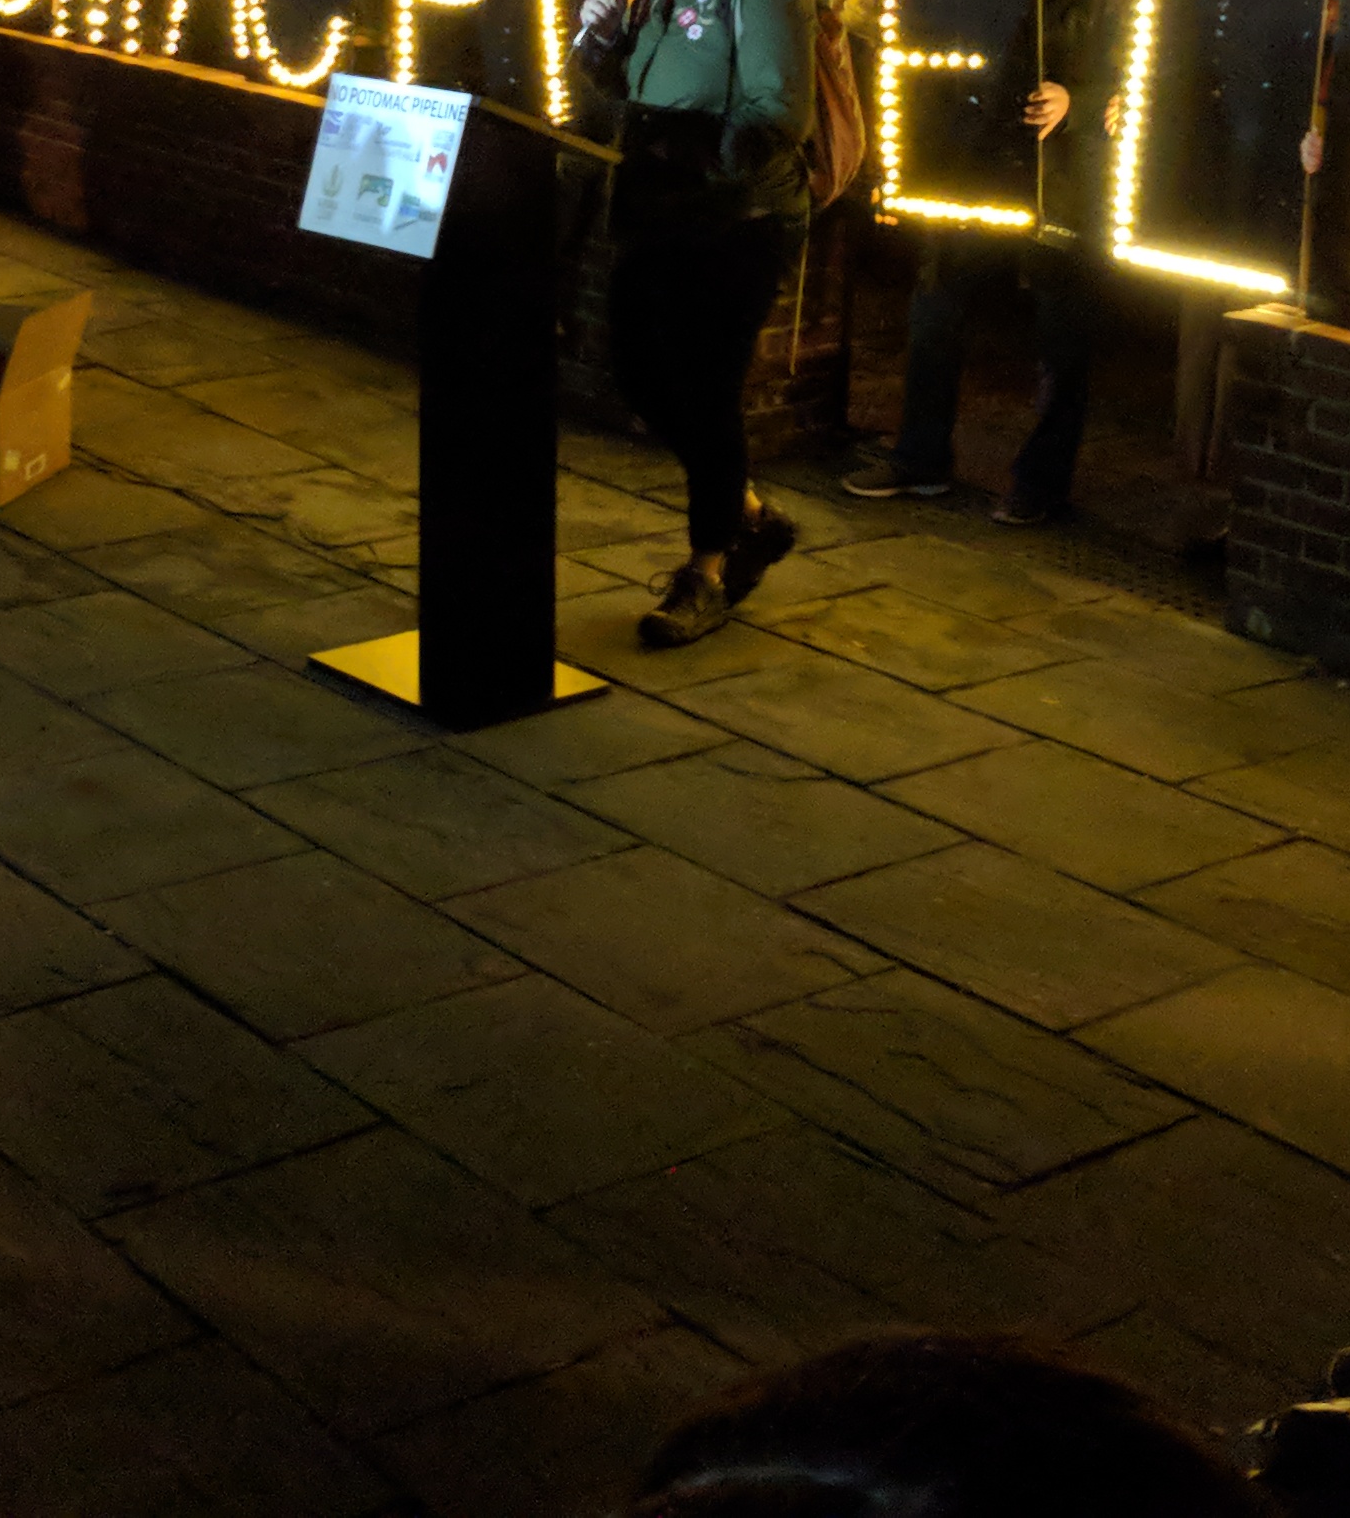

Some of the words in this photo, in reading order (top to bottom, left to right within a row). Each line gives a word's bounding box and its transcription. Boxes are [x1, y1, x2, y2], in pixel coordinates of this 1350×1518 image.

[331, 84, 348, 102] NO
[349, 88, 410, 112] POTOMAC
[412, 97, 468, 122] PIPELINE
